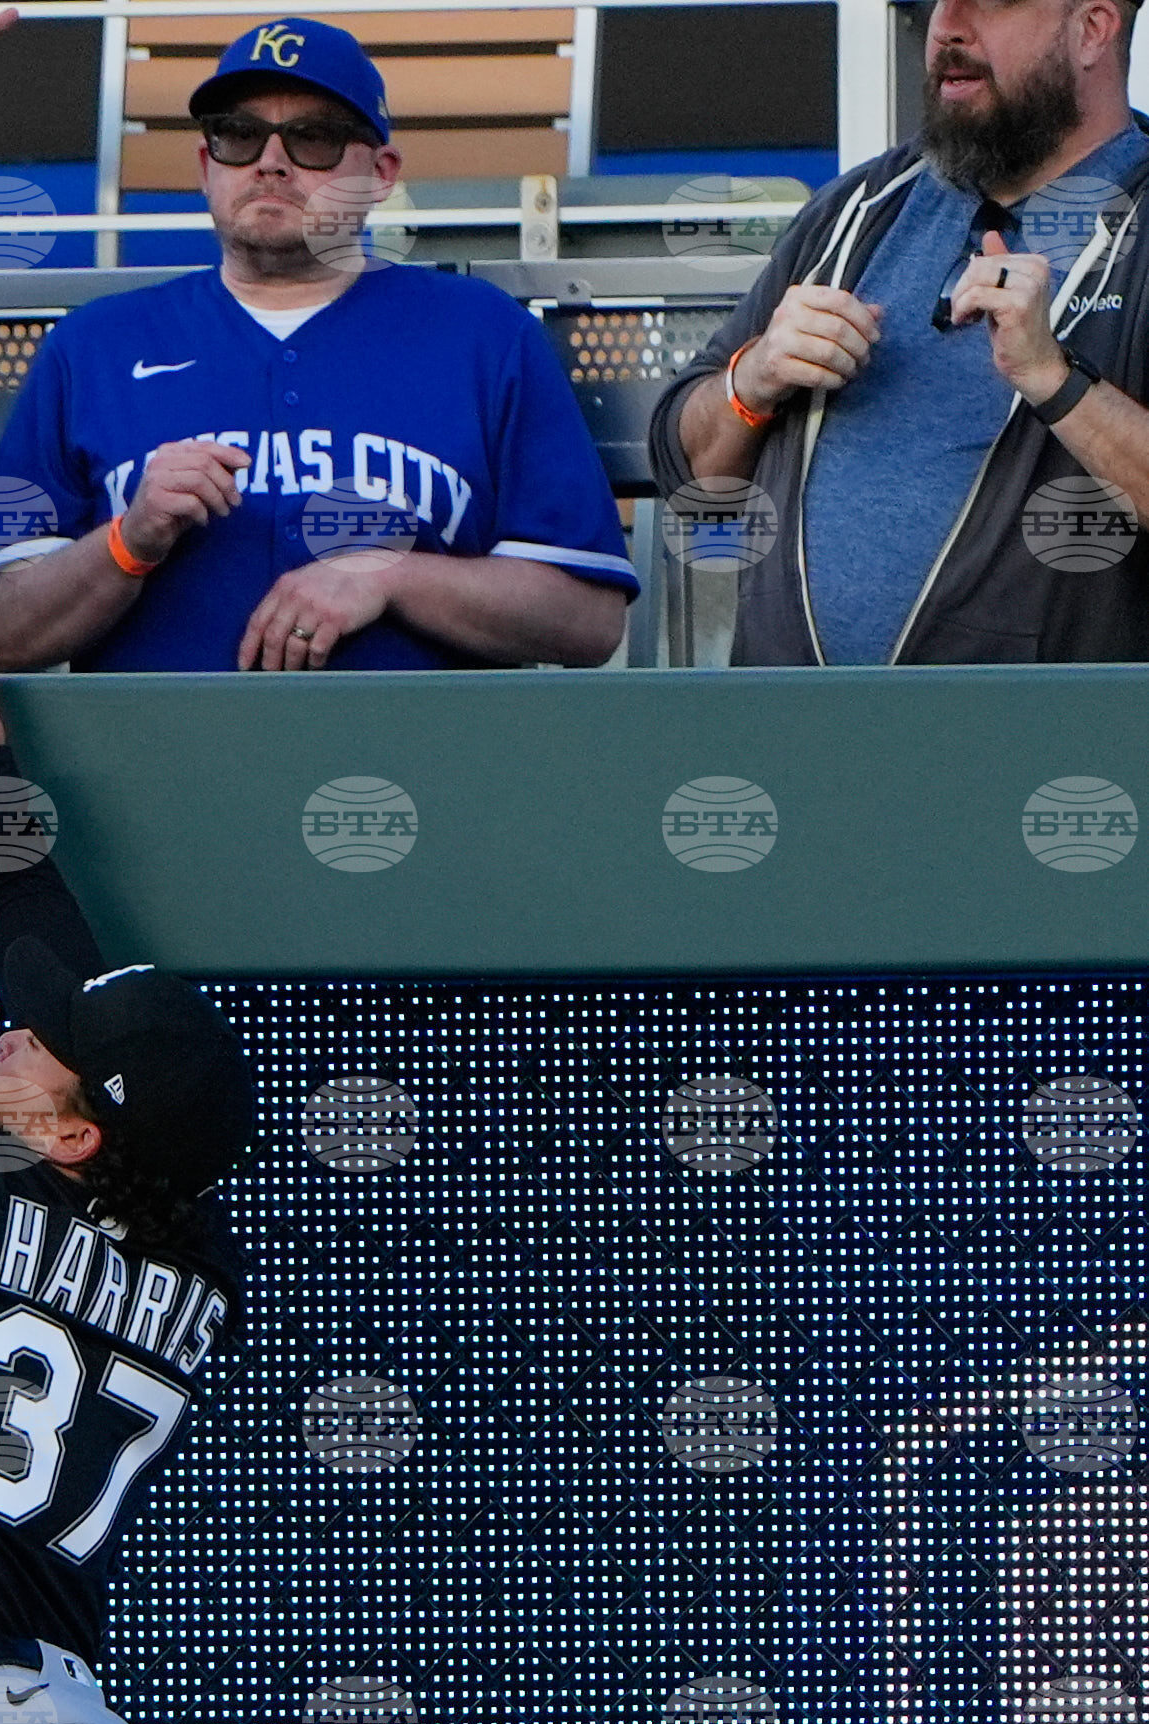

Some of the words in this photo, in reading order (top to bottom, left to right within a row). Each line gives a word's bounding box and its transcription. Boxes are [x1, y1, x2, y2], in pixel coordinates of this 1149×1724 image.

[250, 24, 305, 67] KC
[104, 429, 334, 518] KAS
[353, 432, 472, 546] CITY
